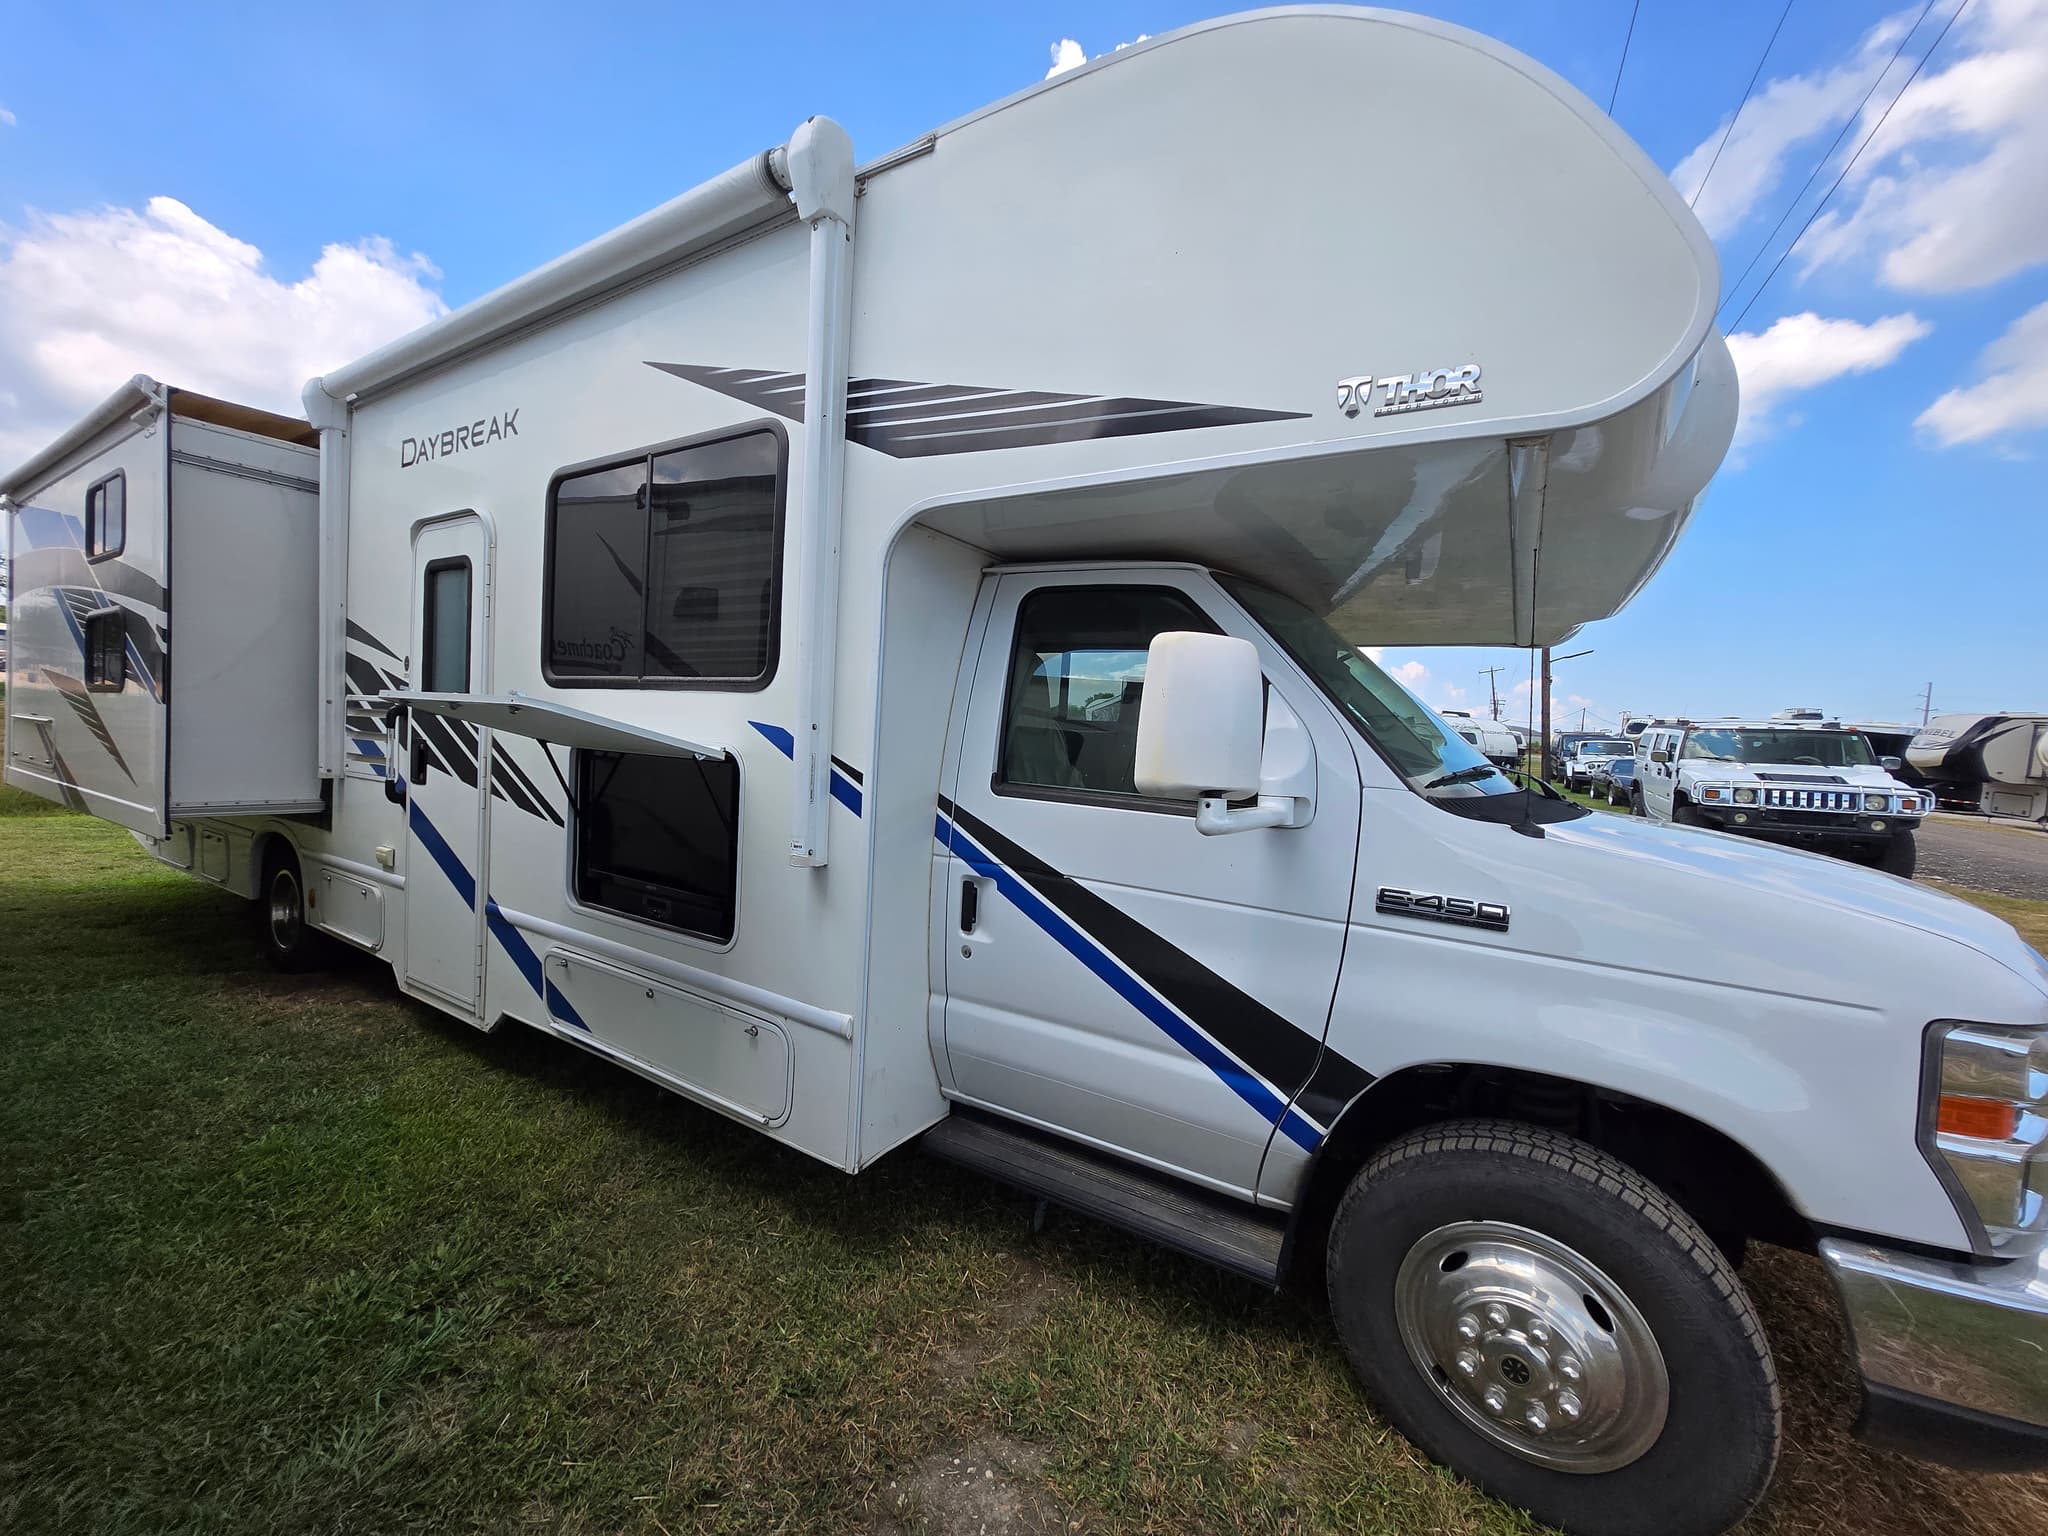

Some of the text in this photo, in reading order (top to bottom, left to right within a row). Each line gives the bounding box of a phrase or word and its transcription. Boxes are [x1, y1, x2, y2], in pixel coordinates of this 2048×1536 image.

[1375, 393, 1482, 414] MOTOR COACH
[1376, 363, 1482, 407] THOR
[401, 408, 519, 468] DAYBREAK
